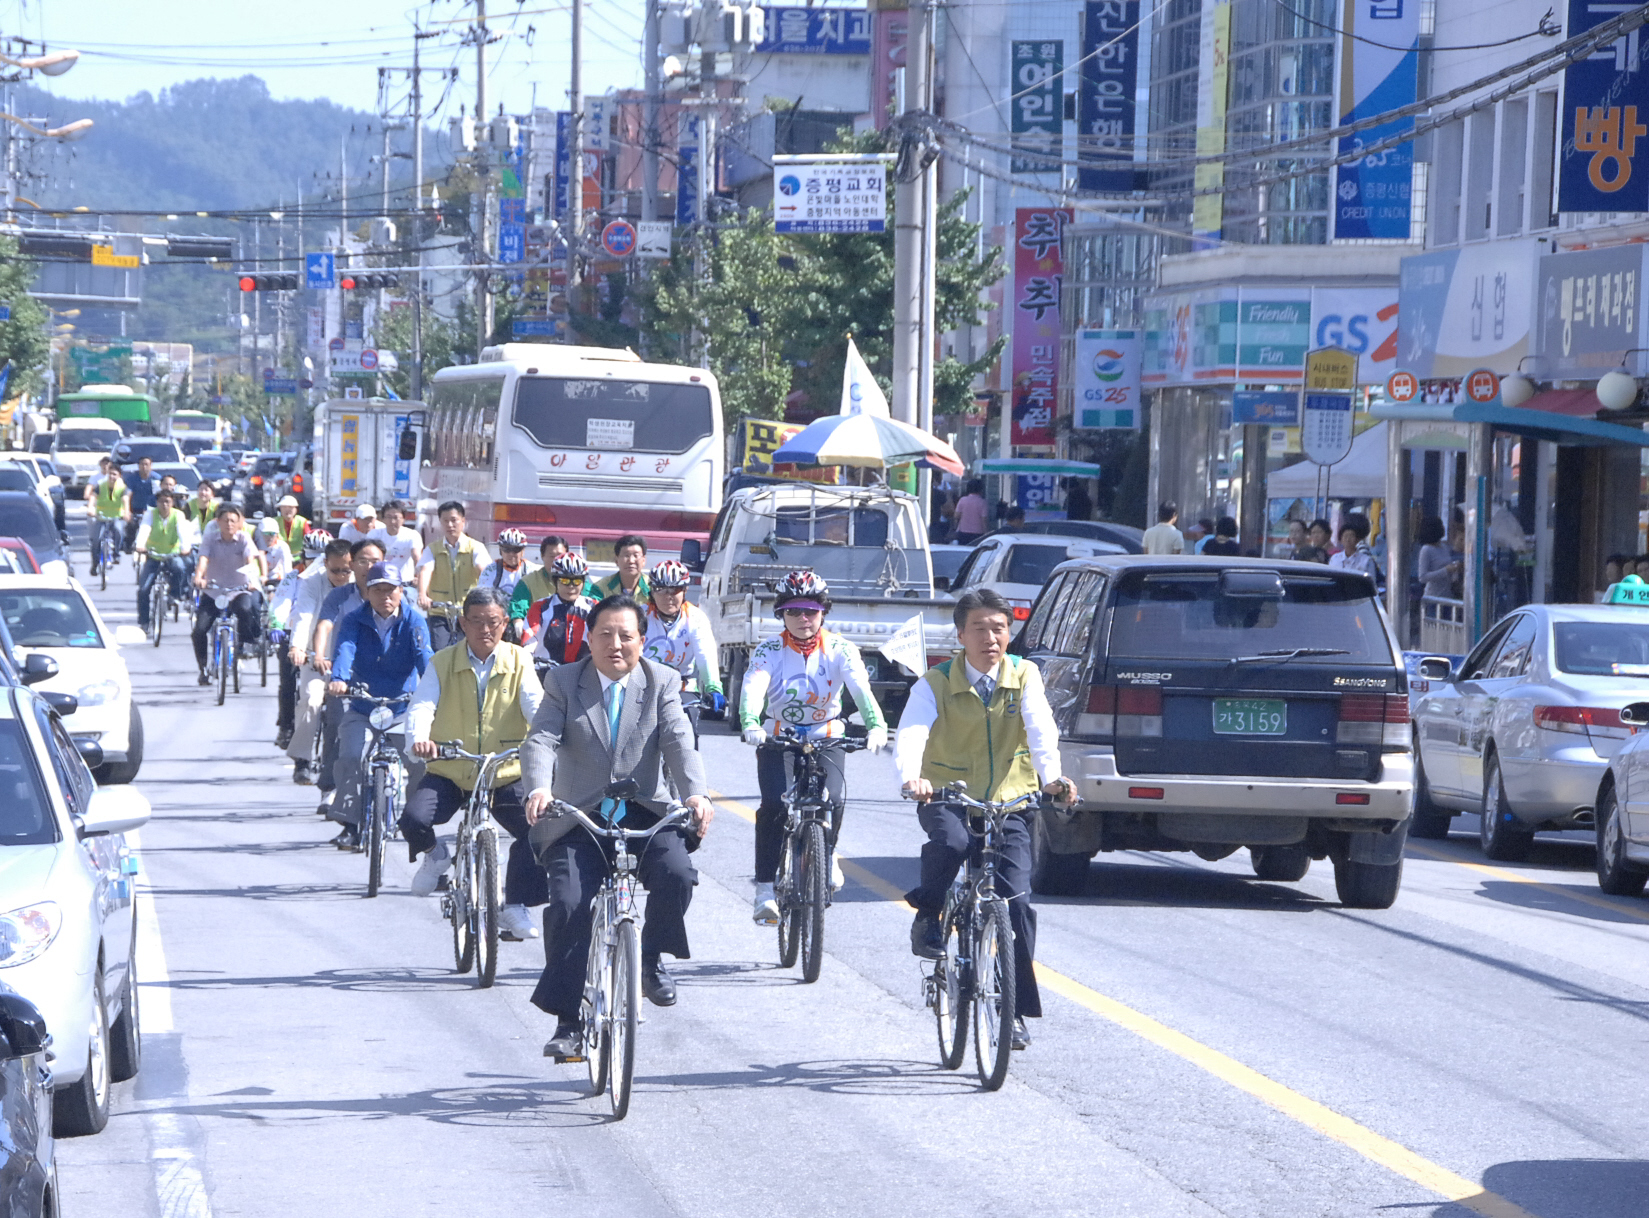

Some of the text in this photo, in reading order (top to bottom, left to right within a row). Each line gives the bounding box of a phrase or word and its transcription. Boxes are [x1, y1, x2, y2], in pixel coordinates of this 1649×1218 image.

[1017, 43, 1056, 59] 초원
[1092, 0, 1129, 152] 신한은행
[1018, 61, 1054, 153] 여인숙
[1575, 105, 1647, 193] 빵
[806, 177, 882, 193] 증평교회
[1342, 206, 1406, 219] CREDIT UNION
[1472, 271, 1507, 341] 신협
[1600, 269, 1635, 333] 제과점
[1248, 304, 1299, 326] Friendly
[1259, 347, 1284, 364] Fun
[1314, 363, 1349, 375] 시내버스
[1314, 377, 1347, 388] BUS STOP
[1085, 386, 1132, 403] GS25
[1117, 672, 1173, 680] MUSSO
